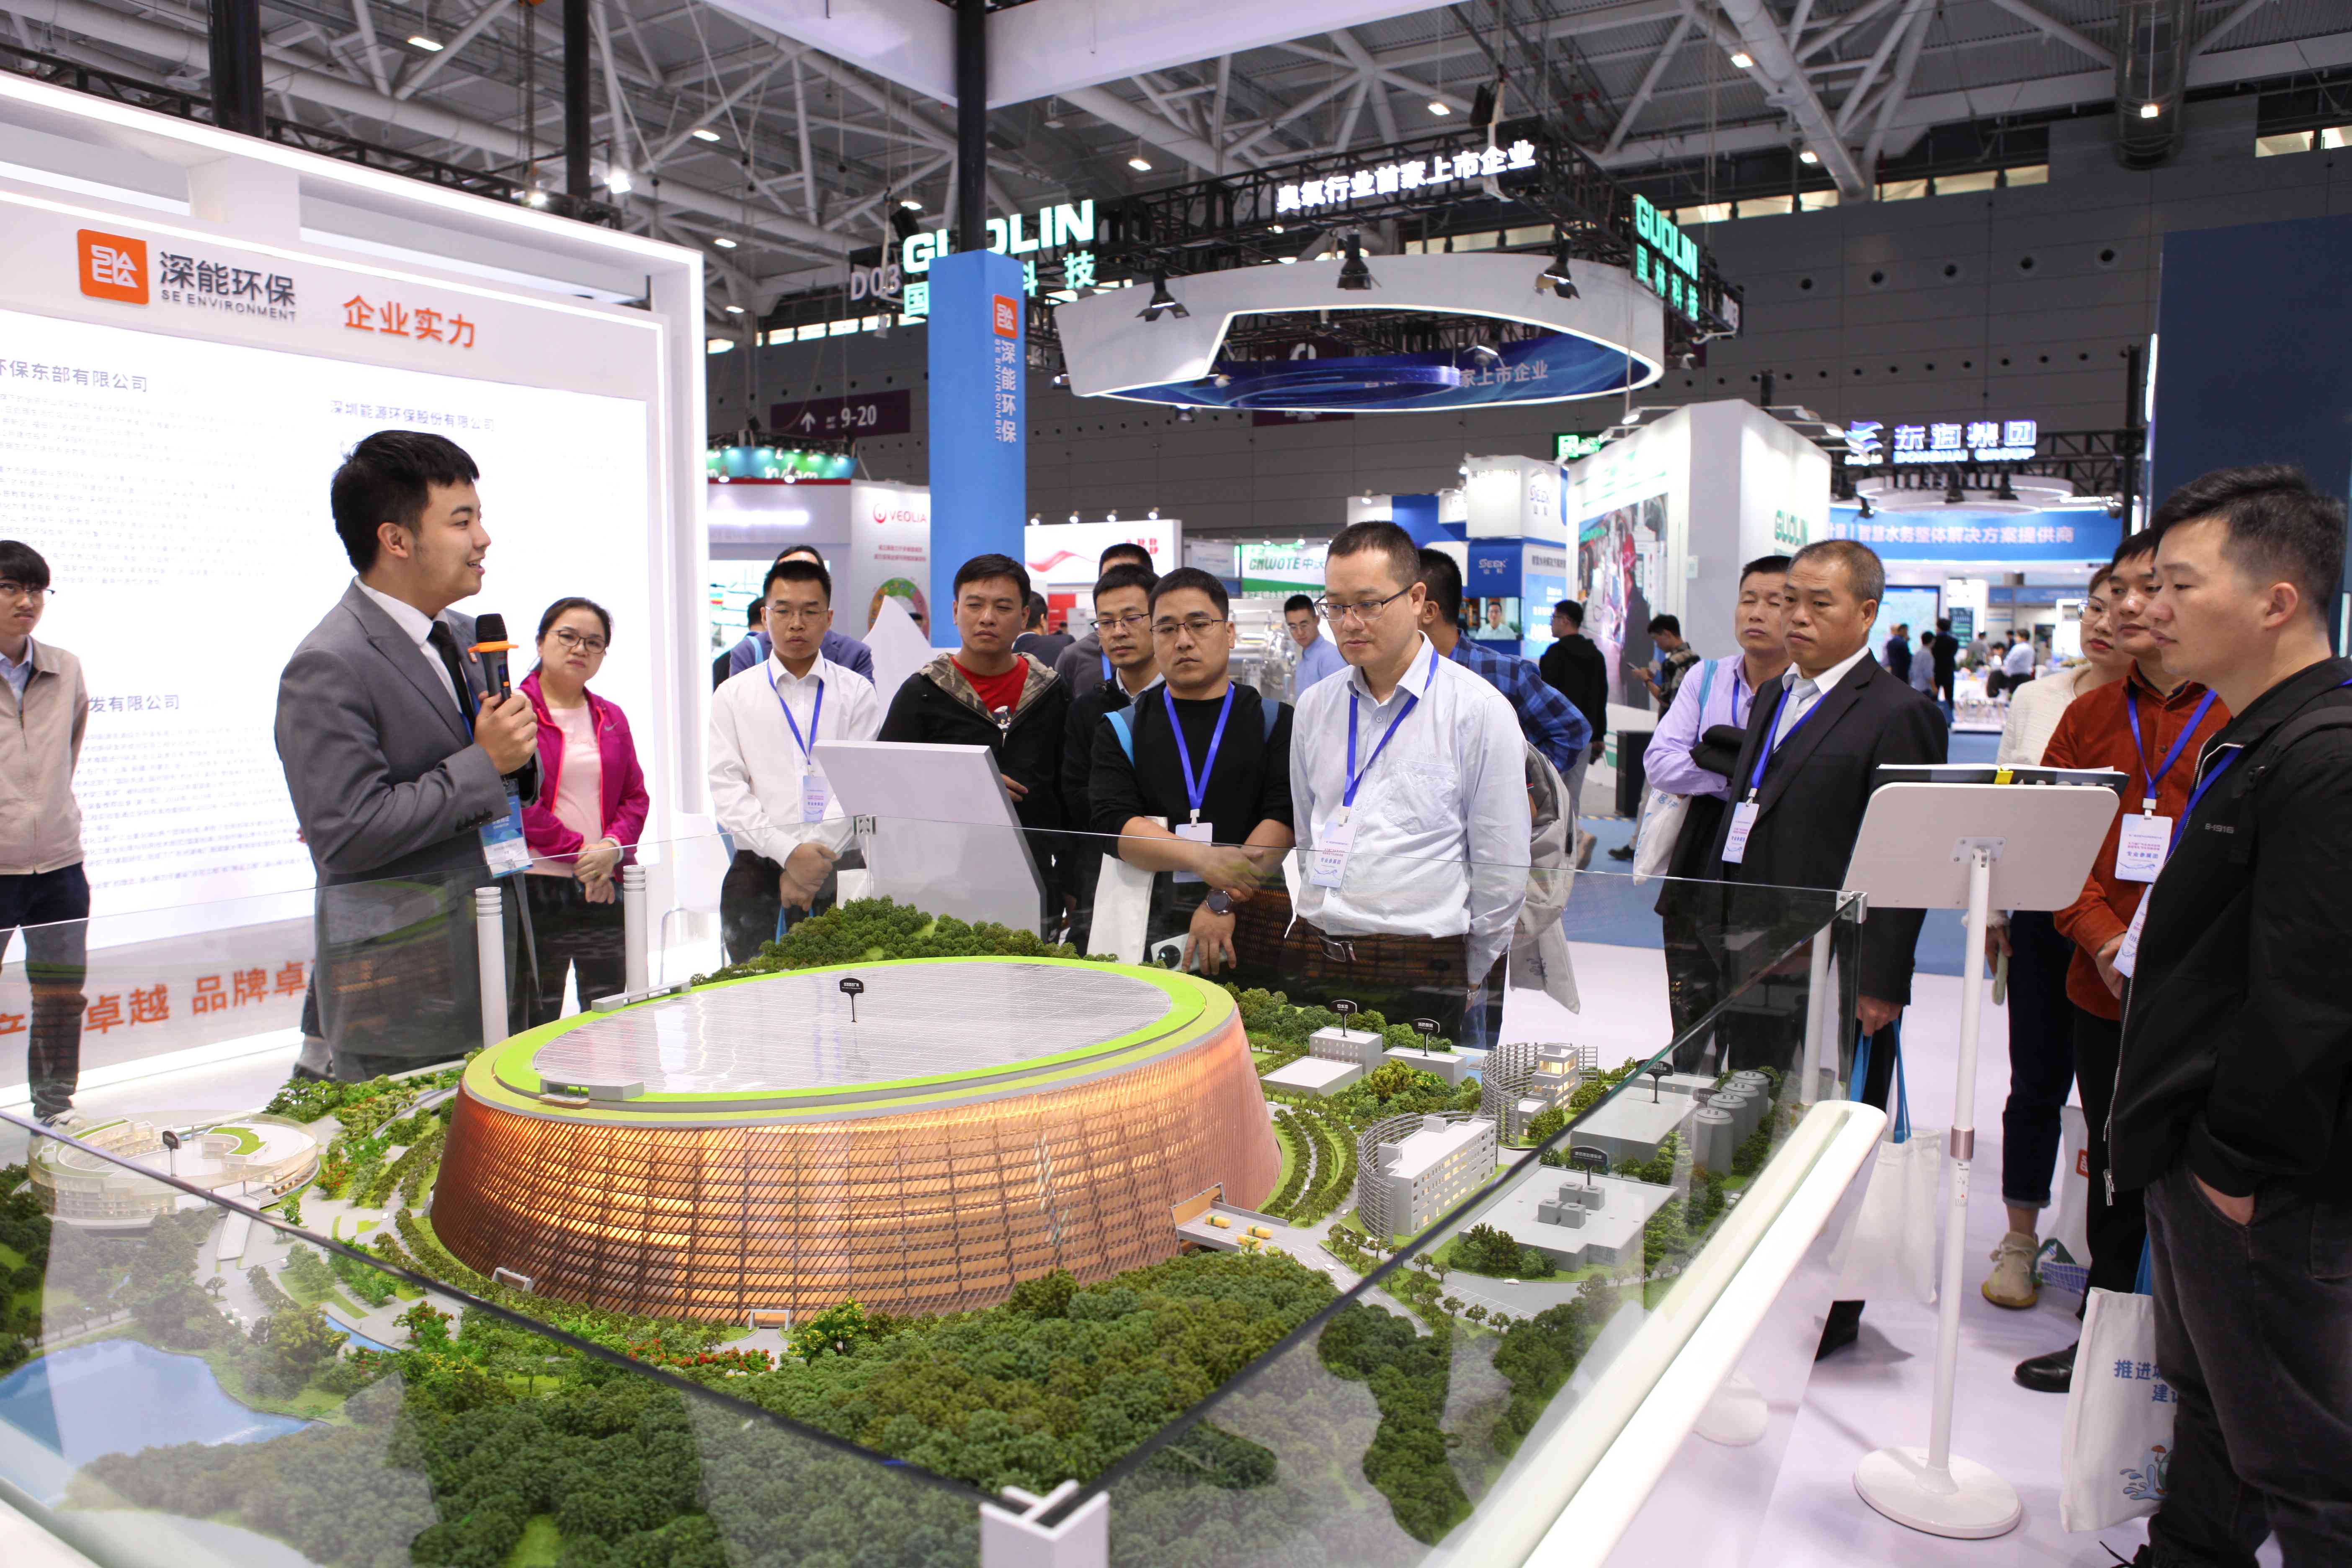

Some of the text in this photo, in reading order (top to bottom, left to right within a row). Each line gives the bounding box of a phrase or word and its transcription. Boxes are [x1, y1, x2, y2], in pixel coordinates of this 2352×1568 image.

[1635, 193, 1698, 281] GUOLIN
[160, 251, 296, 306] 深能环保
[162, 289, 297, 322] SE ENVIRONMENT
[343, 294, 476, 348] 企业实力
[1001, 340, 1017, 443] 深能环保
[330, 400, 495, 431] 深圳能源环保股份有限公司
[841, 404, 877, 428] 9-20
[890, 511, 928, 523] VEOLIA
